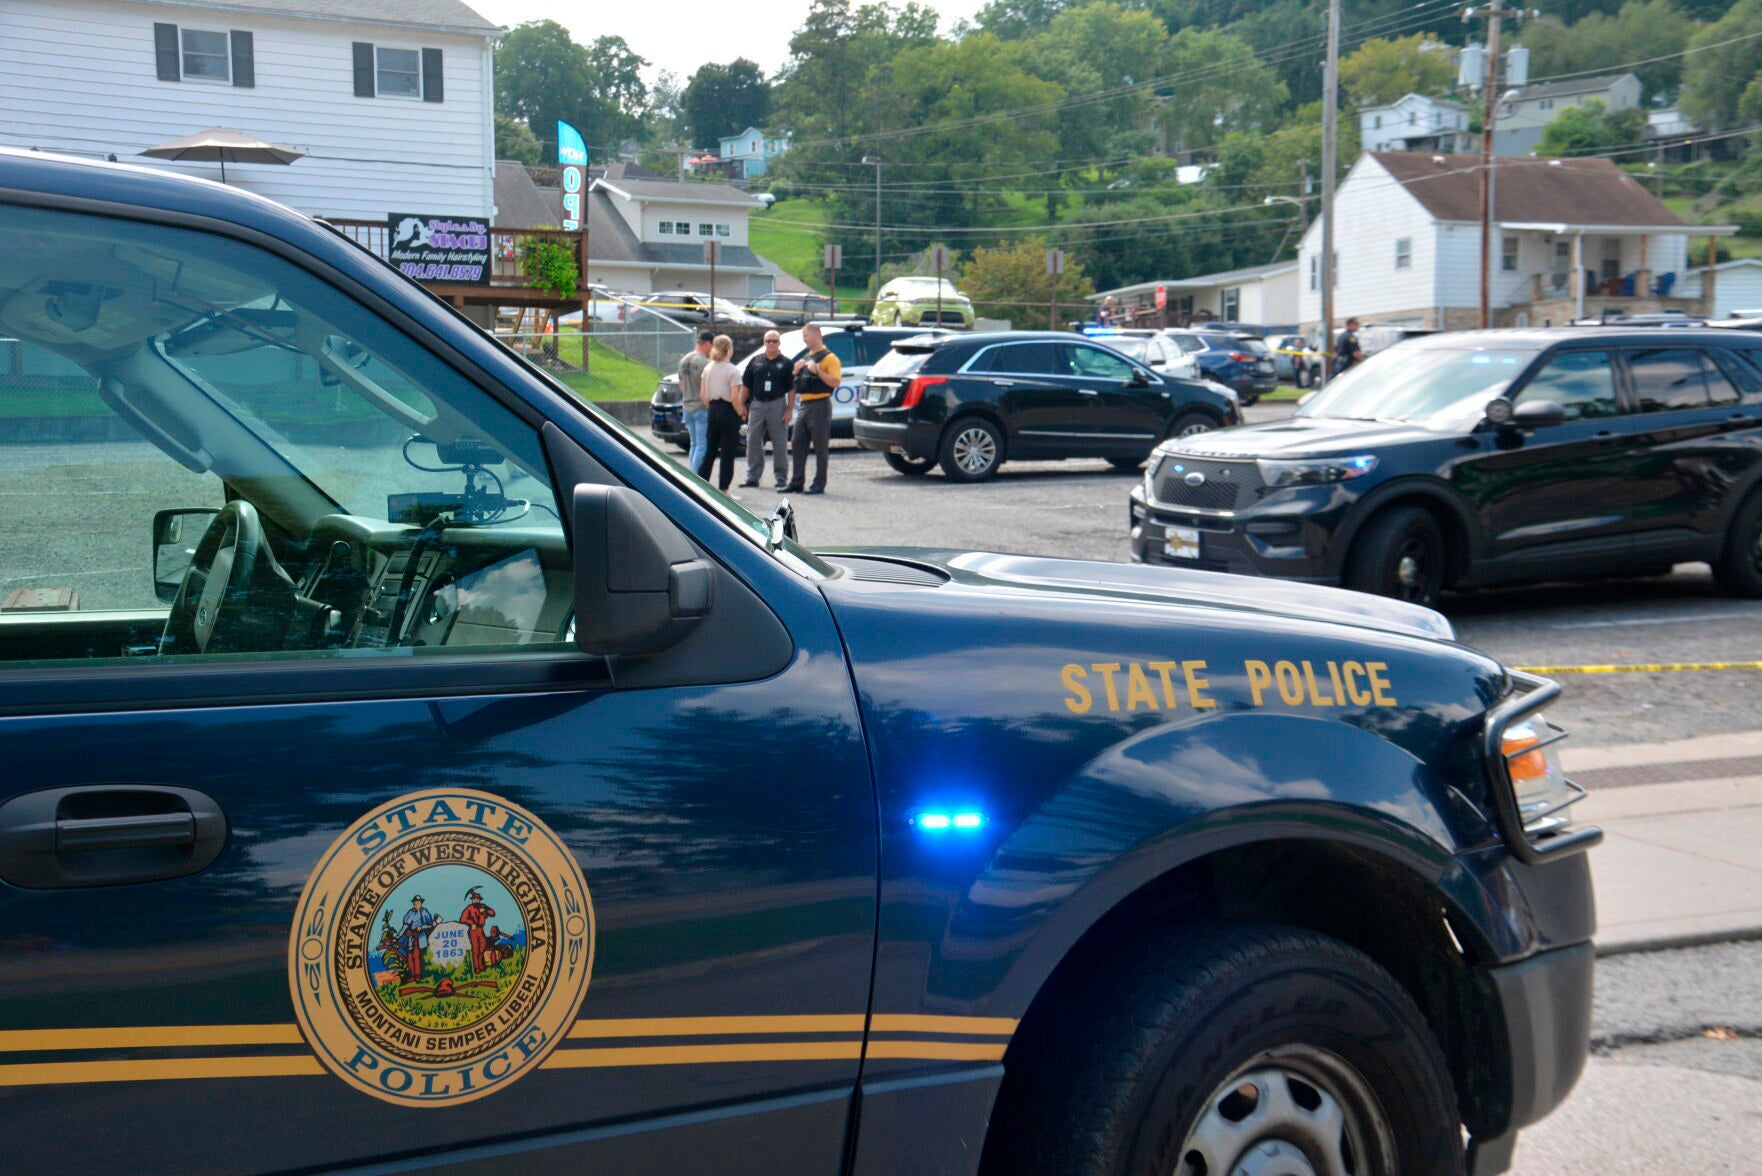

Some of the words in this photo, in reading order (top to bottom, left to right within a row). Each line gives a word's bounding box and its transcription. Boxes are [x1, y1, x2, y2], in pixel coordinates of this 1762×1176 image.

[391, 249, 420, 260] Modern
[421, 250, 447, 263] Family
[447, 251, 487, 264] Hairstyling
[1060, 660, 1217, 714] STATE
[1244, 660, 1397, 707] POLICE
[356, 799, 533, 855] STATE
[346, 889, 381, 970] STATE
[378, 859, 406, 890] OF
[413, 844, 480, 867] WEST
[485, 850, 547, 952] VIRGINIA
[434, 928, 465, 940] JUNE
[435, 948, 464, 959] 1863
[442, 939, 458, 949] 20
[355, 989, 421, 1050] MONTANI
[425, 1021, 497, 1051] SEMPER
[499, 974, 539, 1027] LIBERI
[344, 1026, 547, 1097] POLICE
